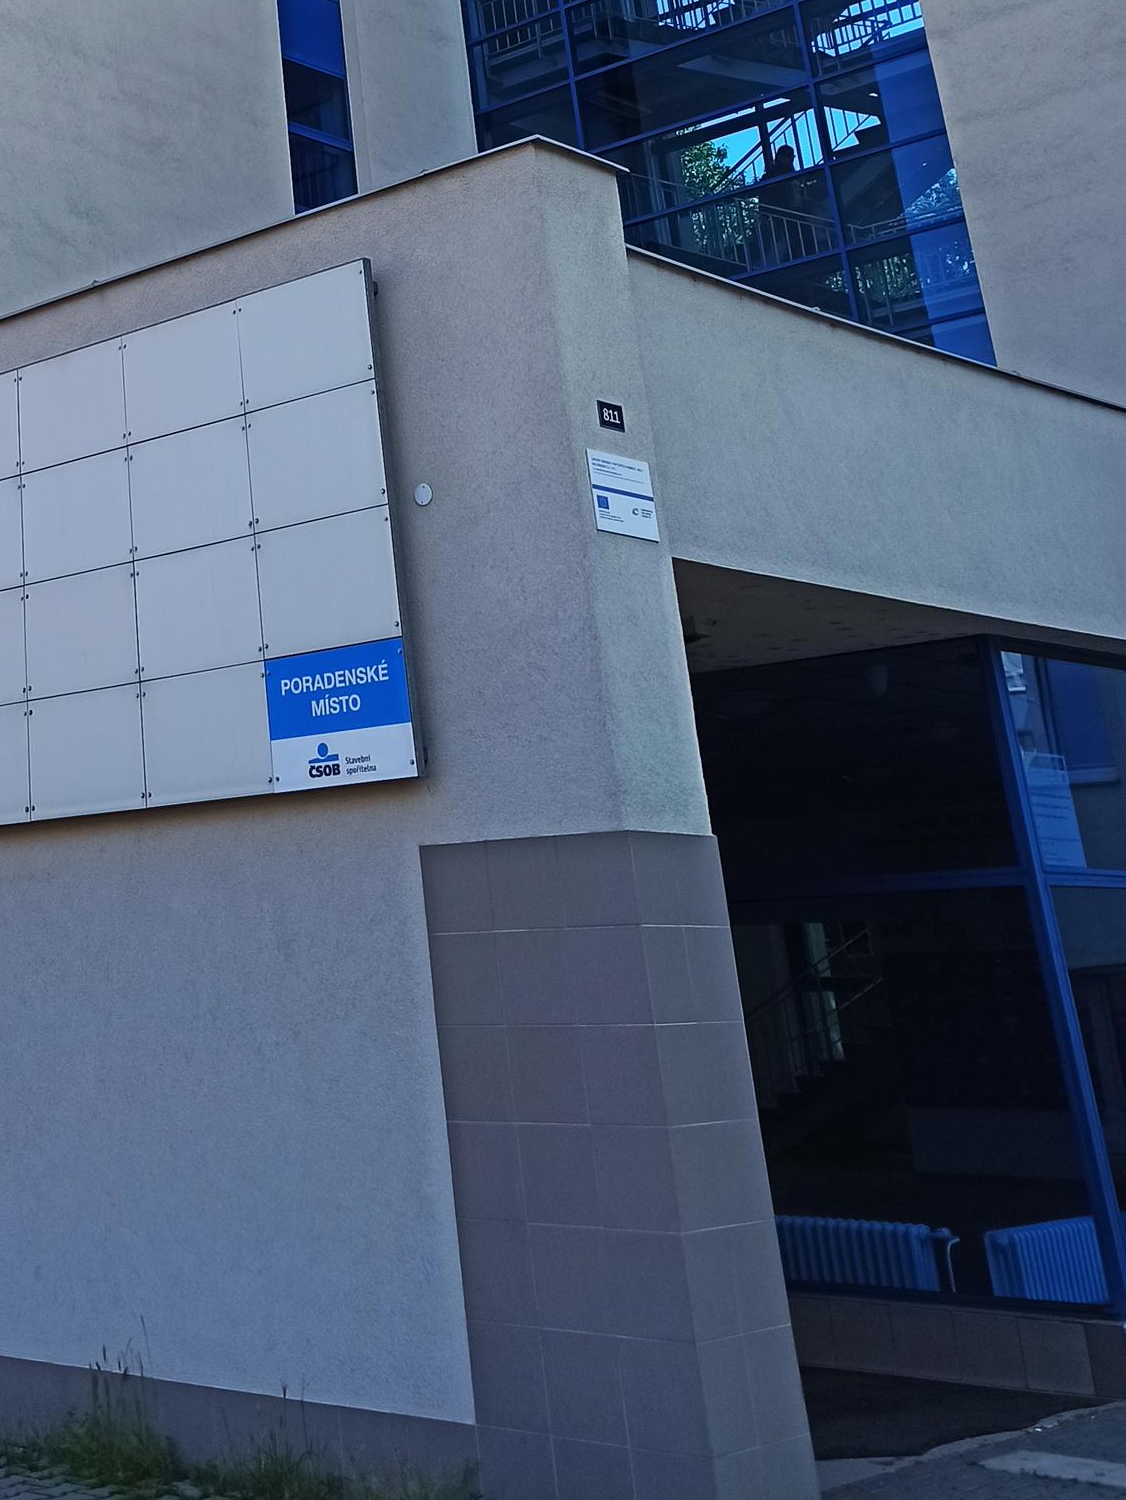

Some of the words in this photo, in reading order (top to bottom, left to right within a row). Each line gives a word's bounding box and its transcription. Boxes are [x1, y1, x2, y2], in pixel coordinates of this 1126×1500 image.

[603, 408, 621, 424] 811
[280, 659, 389, 696] PORADENSKÉ
[311, 694, 361, 717] MÍSTO
[345, 754, 371, 765] Stavební
[308, 763, 341, 779] ČSOB
[346, 763, 377, 776] spořitelna
